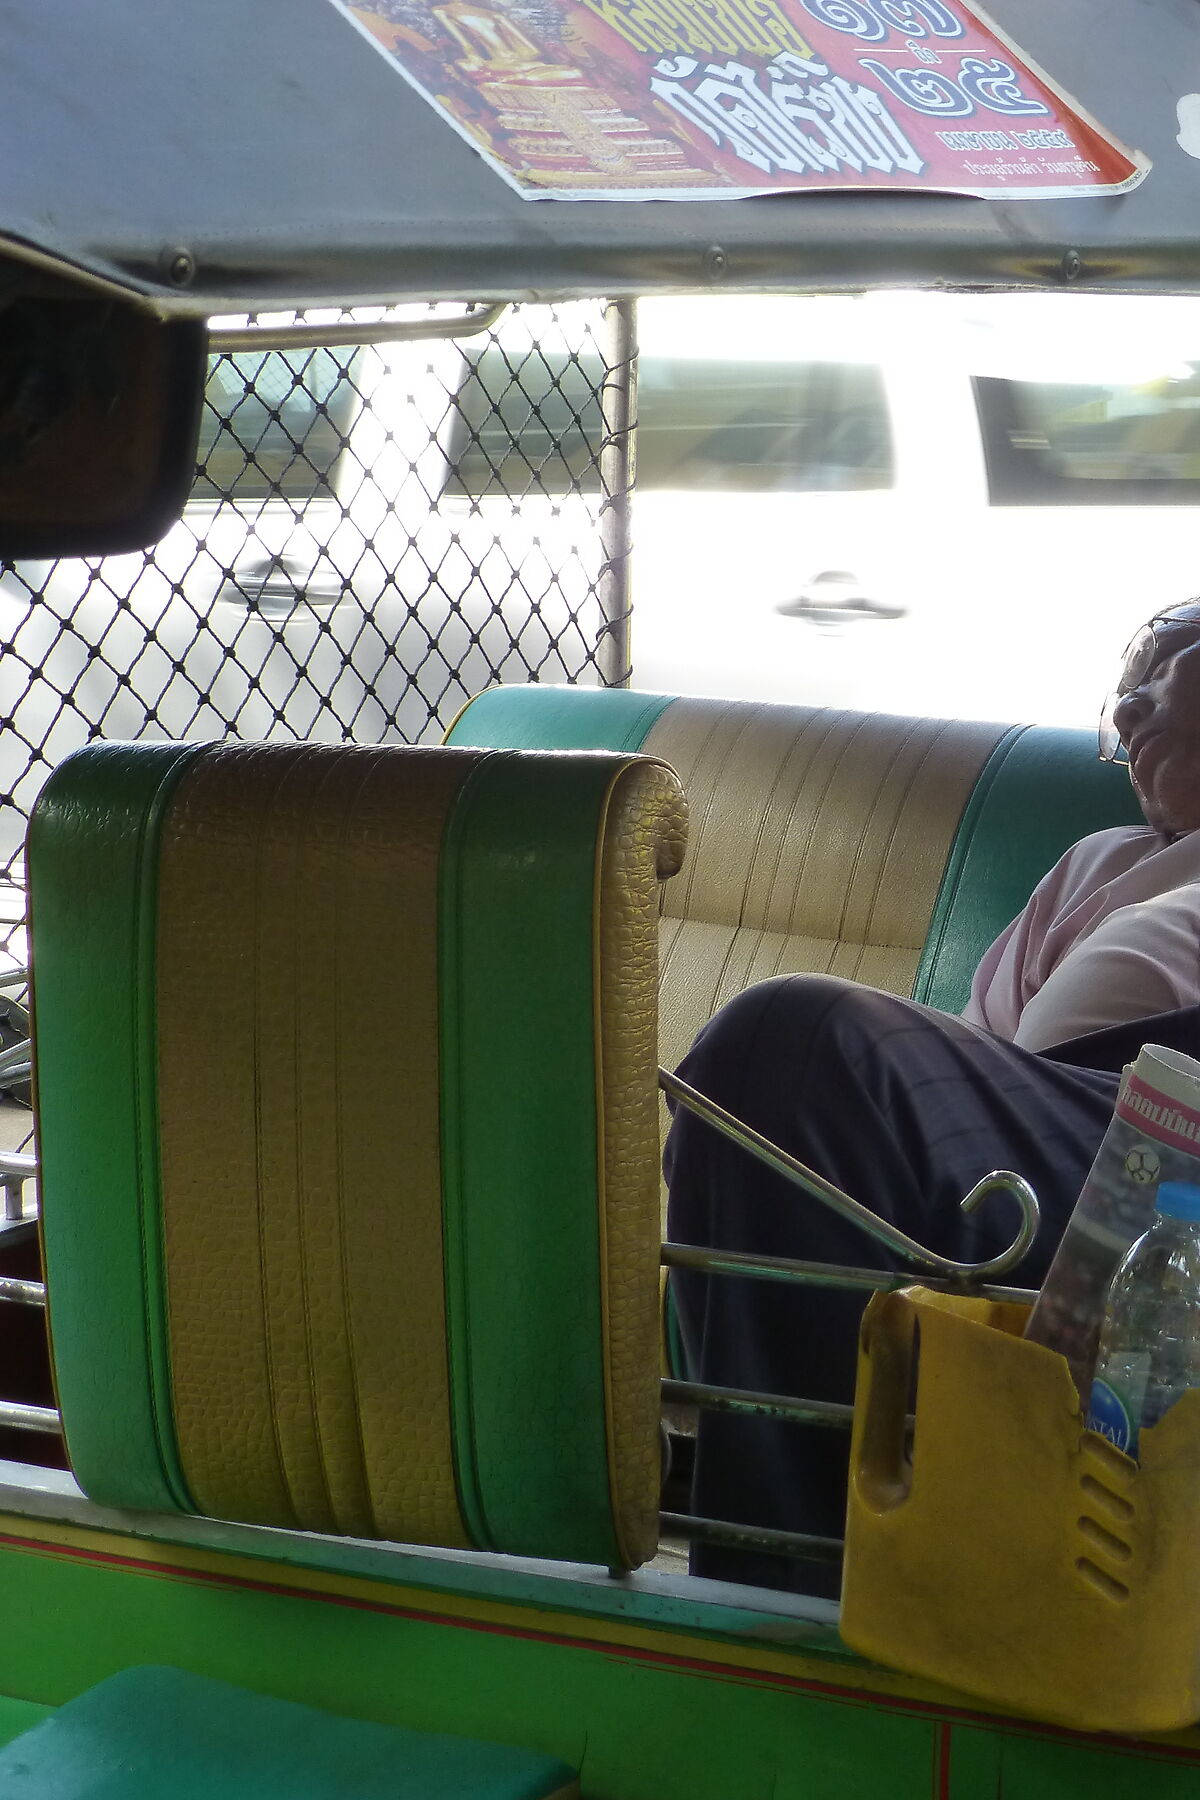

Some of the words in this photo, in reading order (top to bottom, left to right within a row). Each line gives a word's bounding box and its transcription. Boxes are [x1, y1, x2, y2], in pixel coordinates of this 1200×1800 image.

[905, 40, 943, 64] ถึง
[858, 57, 1049, 117] ๒๕
[650, 51, 924, 175] วัดไร่ขิง
[935, 130, 1018, 151] เมษายน
